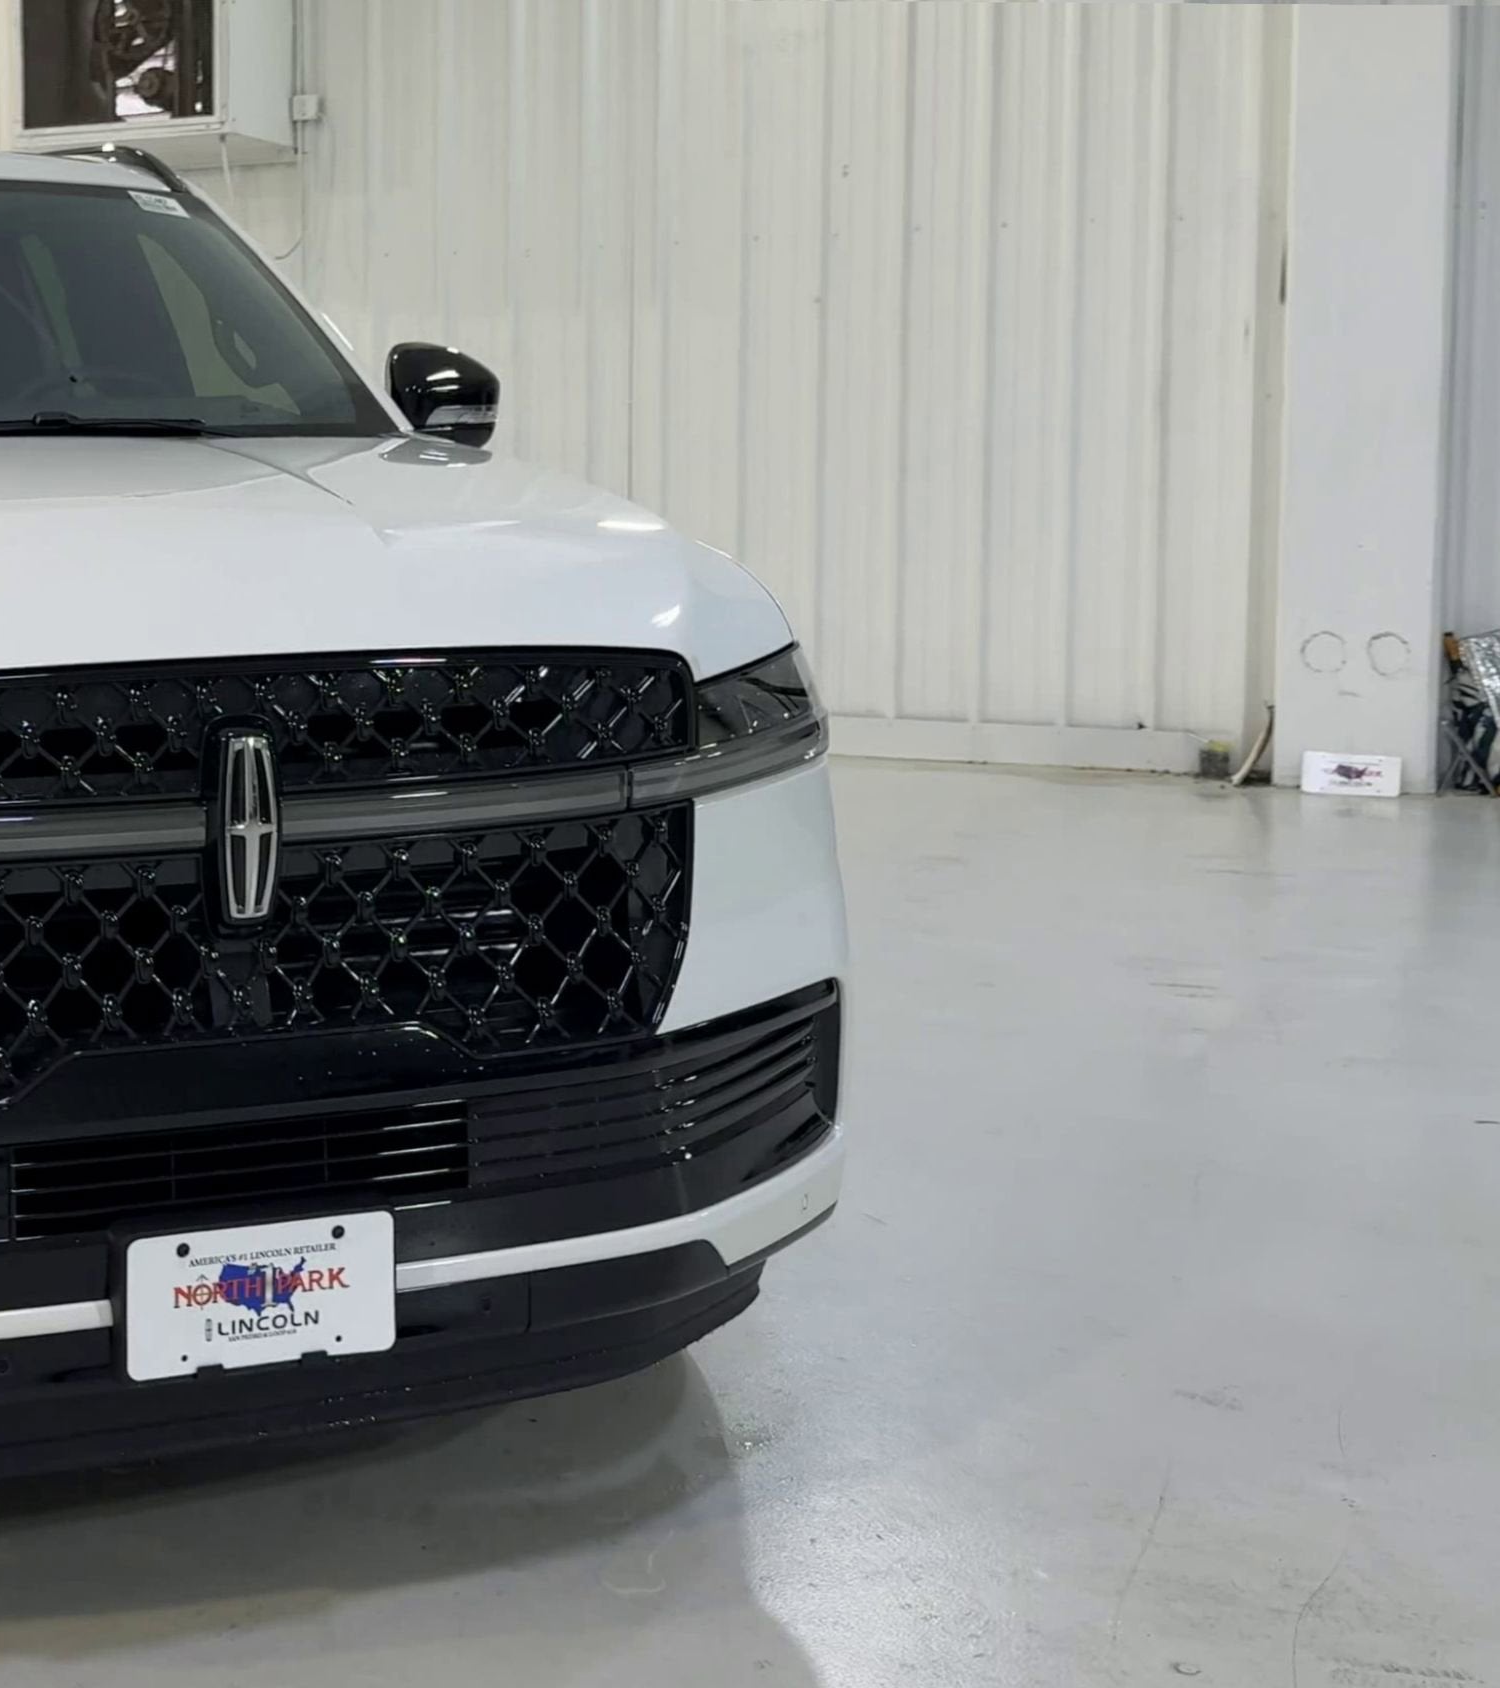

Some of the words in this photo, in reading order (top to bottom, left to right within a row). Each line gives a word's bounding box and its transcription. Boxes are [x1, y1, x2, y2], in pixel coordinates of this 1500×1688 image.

[188, 1254, 236, 1267] AMERICA'S
[250, 1248, 292, 1260] LINCOLN
[293, 1243, 336, 1255] RETAILER
[173, 1278, 262, 1308] NORTH
[276, 1267, 350, 1293] PARK
[217, 1310, 319, 1336] LINCOLN
